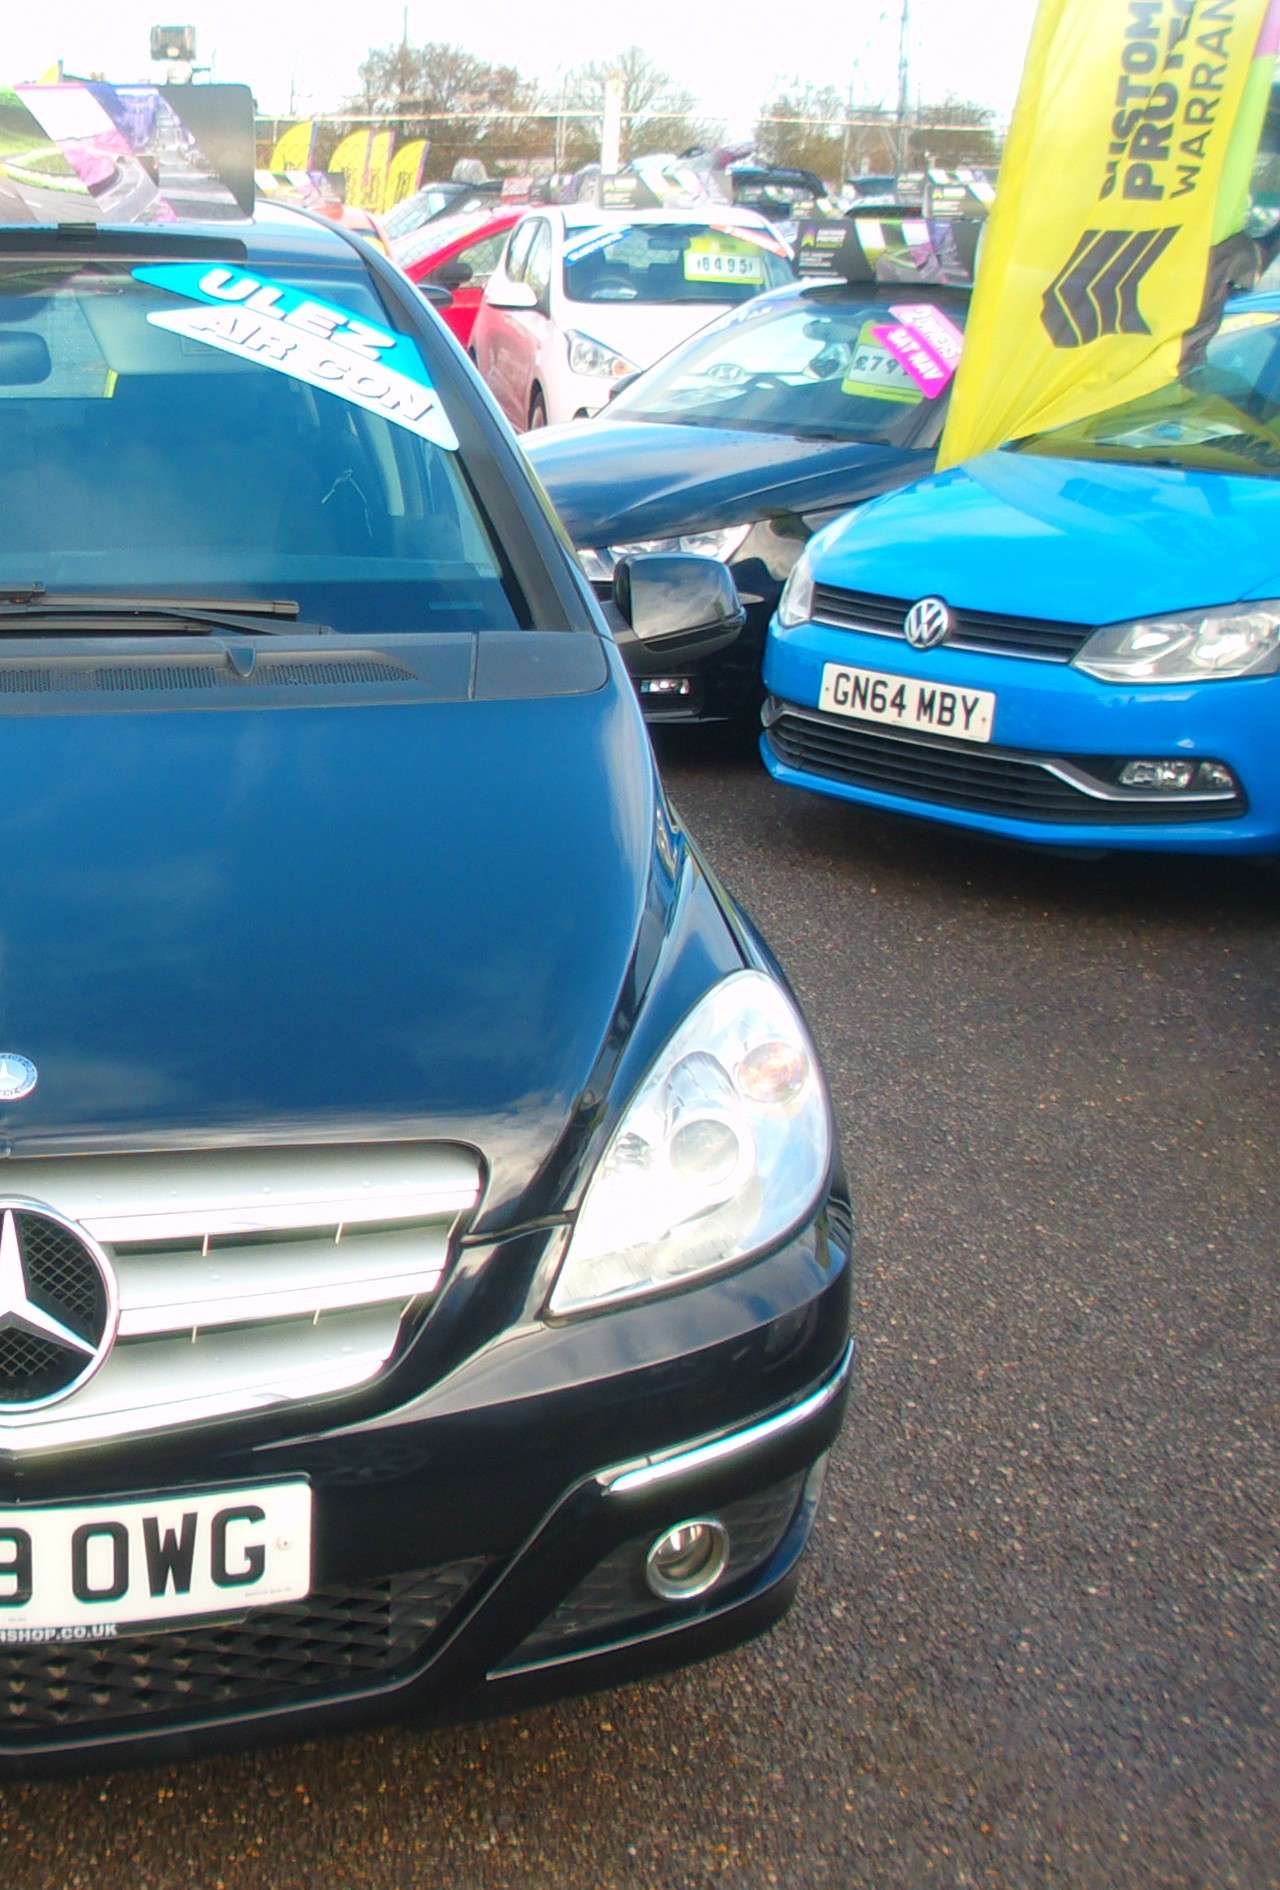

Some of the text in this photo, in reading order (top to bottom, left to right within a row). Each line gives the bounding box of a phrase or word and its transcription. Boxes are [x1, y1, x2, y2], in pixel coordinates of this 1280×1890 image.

[198, 268, 396, 362] ULEZ
[192, 313, 434, 420] AIR CON
[854, 355, 908, 377] £79
[887, 328, 920, 354] SAT
[908, 351, 945, 380] NAV
[833, 672, 980, 732] GN64 MBY
[71, 1504, 267, 1603] OWG
